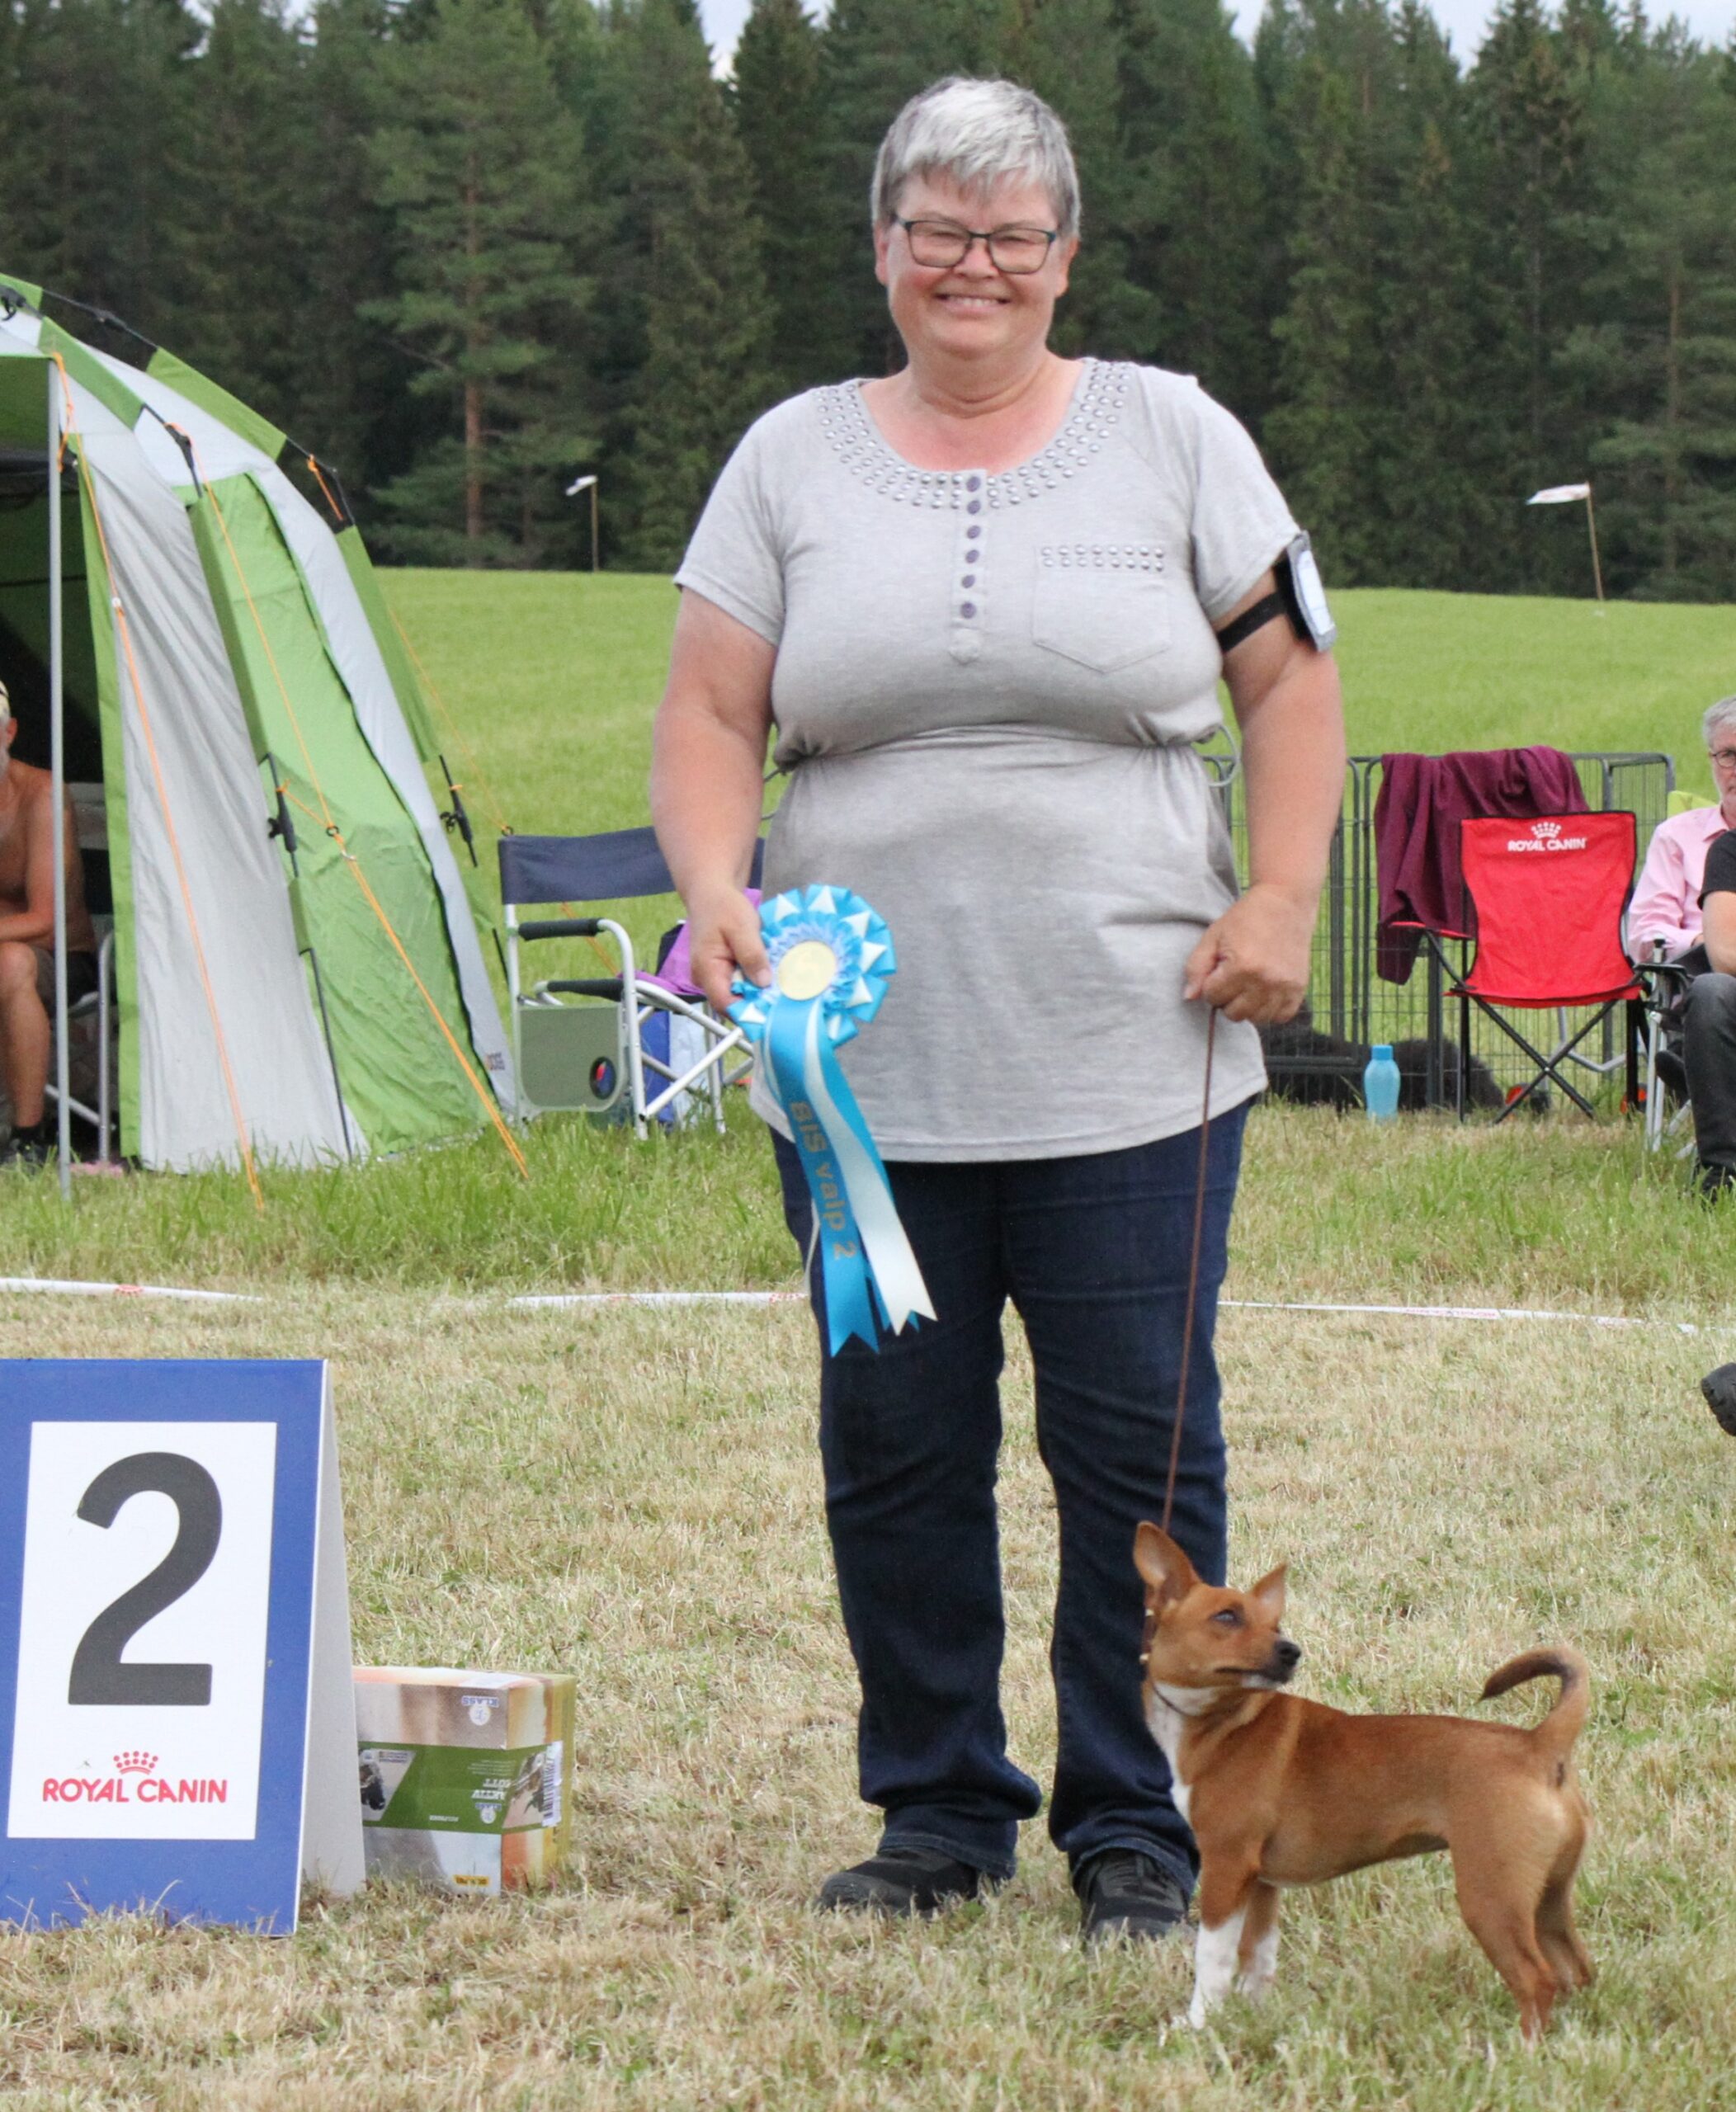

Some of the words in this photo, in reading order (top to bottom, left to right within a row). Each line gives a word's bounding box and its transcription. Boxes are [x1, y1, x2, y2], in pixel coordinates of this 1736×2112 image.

[1507, 840, 1545, 851] ROYAL
[1547, 837, 1586, 851] CANIN
[790, 1102, 827, 1152] BIS
[816, 1162, 846, 1231] valp
[833, 1241, 857, 1261] 2
[68, 1451, 222, 1705] 2
[43, 1779, 130, 1802] ROYAL
[137, 1780, 227, 1803] CANIN
